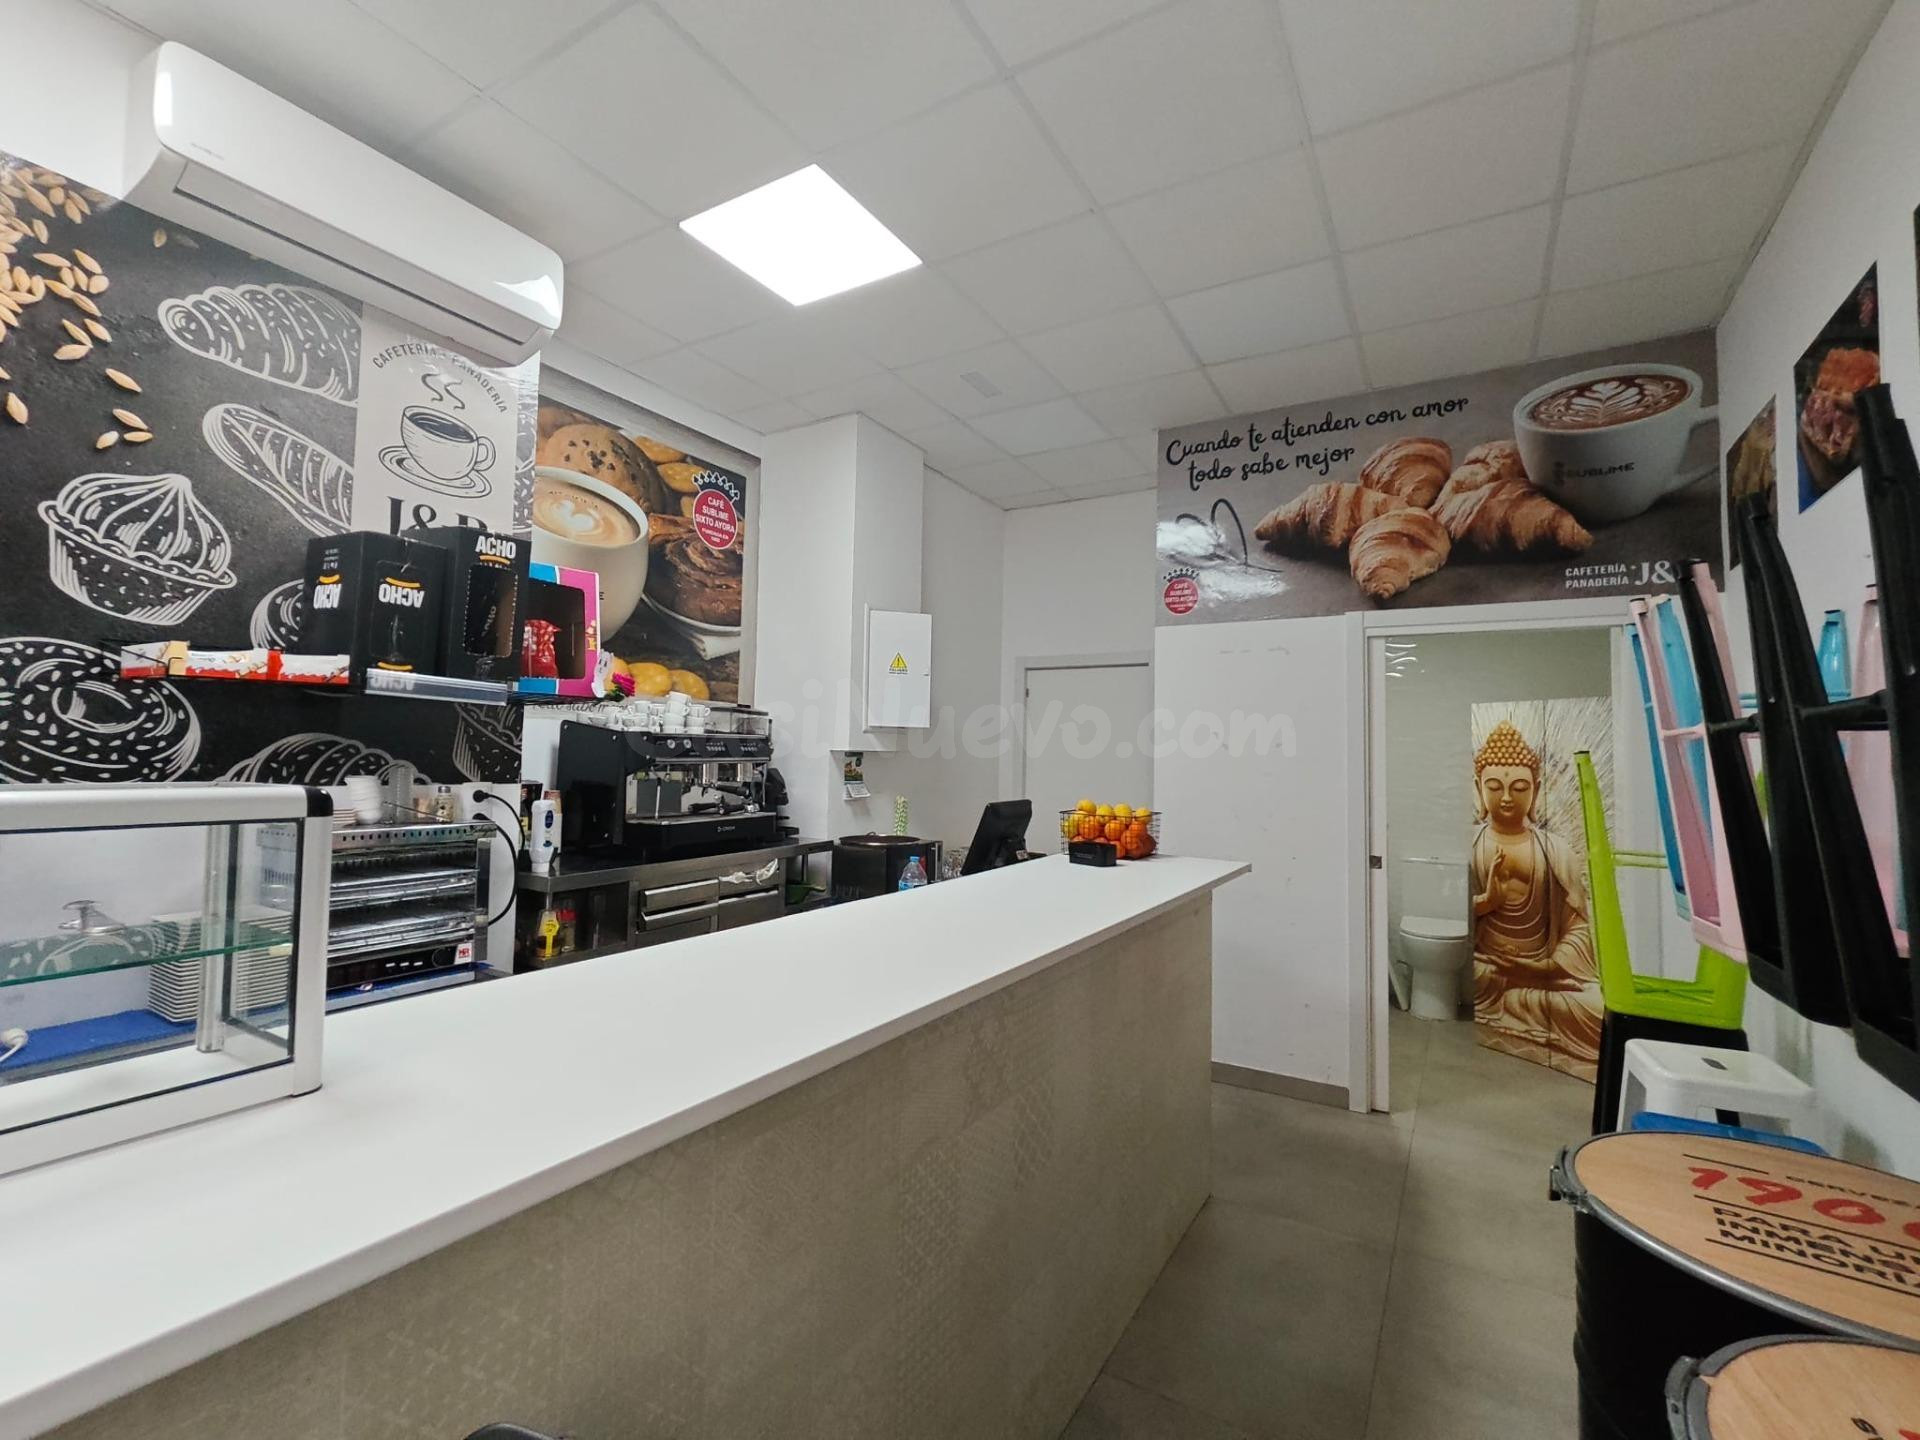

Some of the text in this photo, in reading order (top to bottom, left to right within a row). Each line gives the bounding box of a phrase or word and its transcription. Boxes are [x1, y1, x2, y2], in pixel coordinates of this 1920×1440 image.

[1166, 397, 1469, 466] Cuando te atienden con amor
[1188, 446, 1355, 492] todo sabe mejor
[702, 505, 729, 521] SUBLIME
[707, 496, 725, 510] CAFÉ
[695, 513, 735, 533] SIXTO AYORA
[475, 535, 517, 560] ACHO
[1565, 562, 1627, 577] CAFETERÍA
[1565, 574, 1630, 589] PANADERÍA
[313, 583, 342, 609] ACHO
[378, 583, 425, 609] ACHO
[1688, 1166, 1920, 1241] 190
[1785, 1174, 1920, 1210] CERVEZ
[1712, 1206, 1854, 1249] PARA
[1716, 1217, 1920, 1276] INMENS
[1719, 1228, 1920, 1289] MINORI
